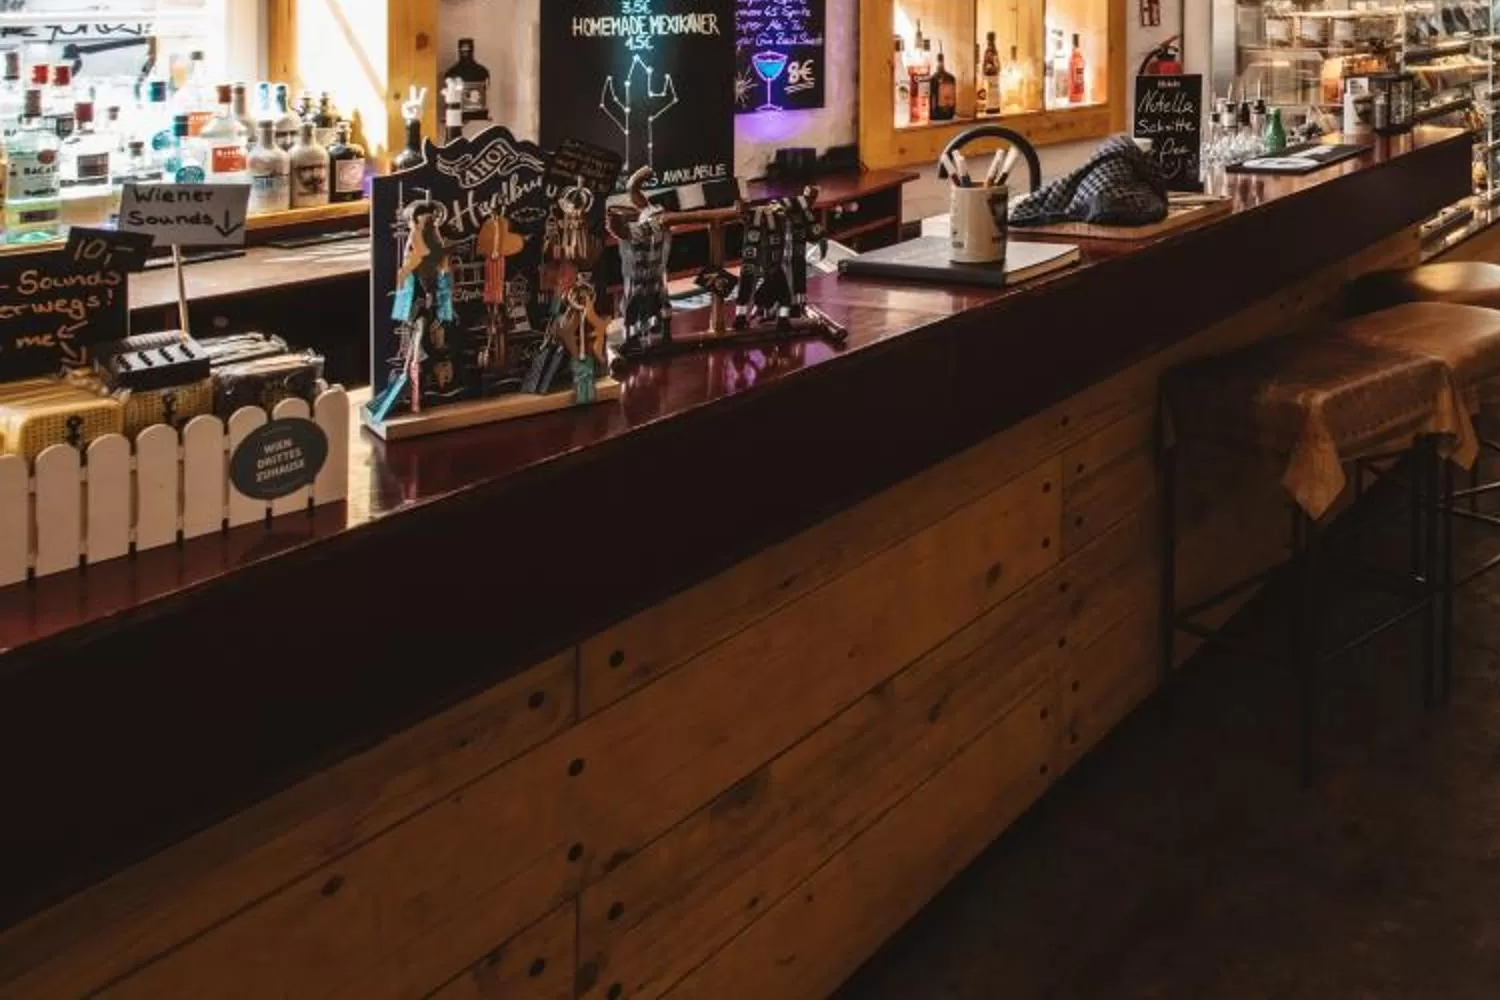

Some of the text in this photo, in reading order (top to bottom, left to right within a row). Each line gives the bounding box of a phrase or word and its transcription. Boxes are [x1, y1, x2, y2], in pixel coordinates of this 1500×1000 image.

[572, 16, 648, 37] HOMEMADE
[650, 13, 720, 37] MEXIKANER
[464, 144, 508, 186] AHOI
[661, 163, 727, 185] AVAILABLE
[133, 186, 214, 203] Wiener
[127, 210, 214, 227] Sounds
[17, 269, 122, 295] Sounds
[257, 447, 303, 470] DRITTES
[256, 459, 305, 483] ZUHAUSE
